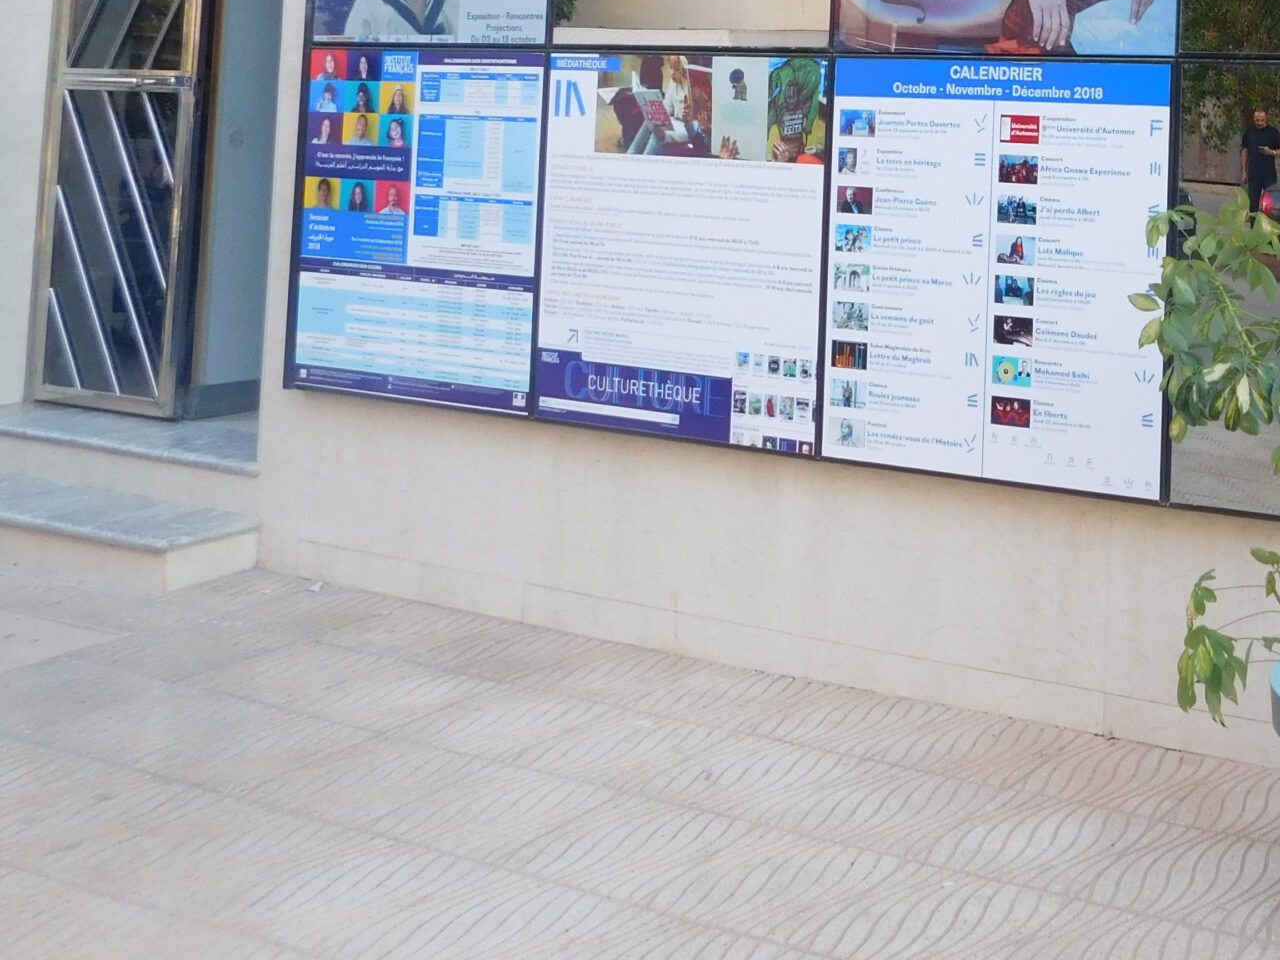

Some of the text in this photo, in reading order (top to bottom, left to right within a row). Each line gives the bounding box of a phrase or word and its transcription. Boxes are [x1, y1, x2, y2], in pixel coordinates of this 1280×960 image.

[556, 58, 607, 69] MÉDIATHÈQUE
[950, 65, 1042, 81] CALENDRIER
[892, 81, 1103, 100] Octobre Novembre Décembre 2018
[588, 374, 701, 404] CULTURETHÈQUE
